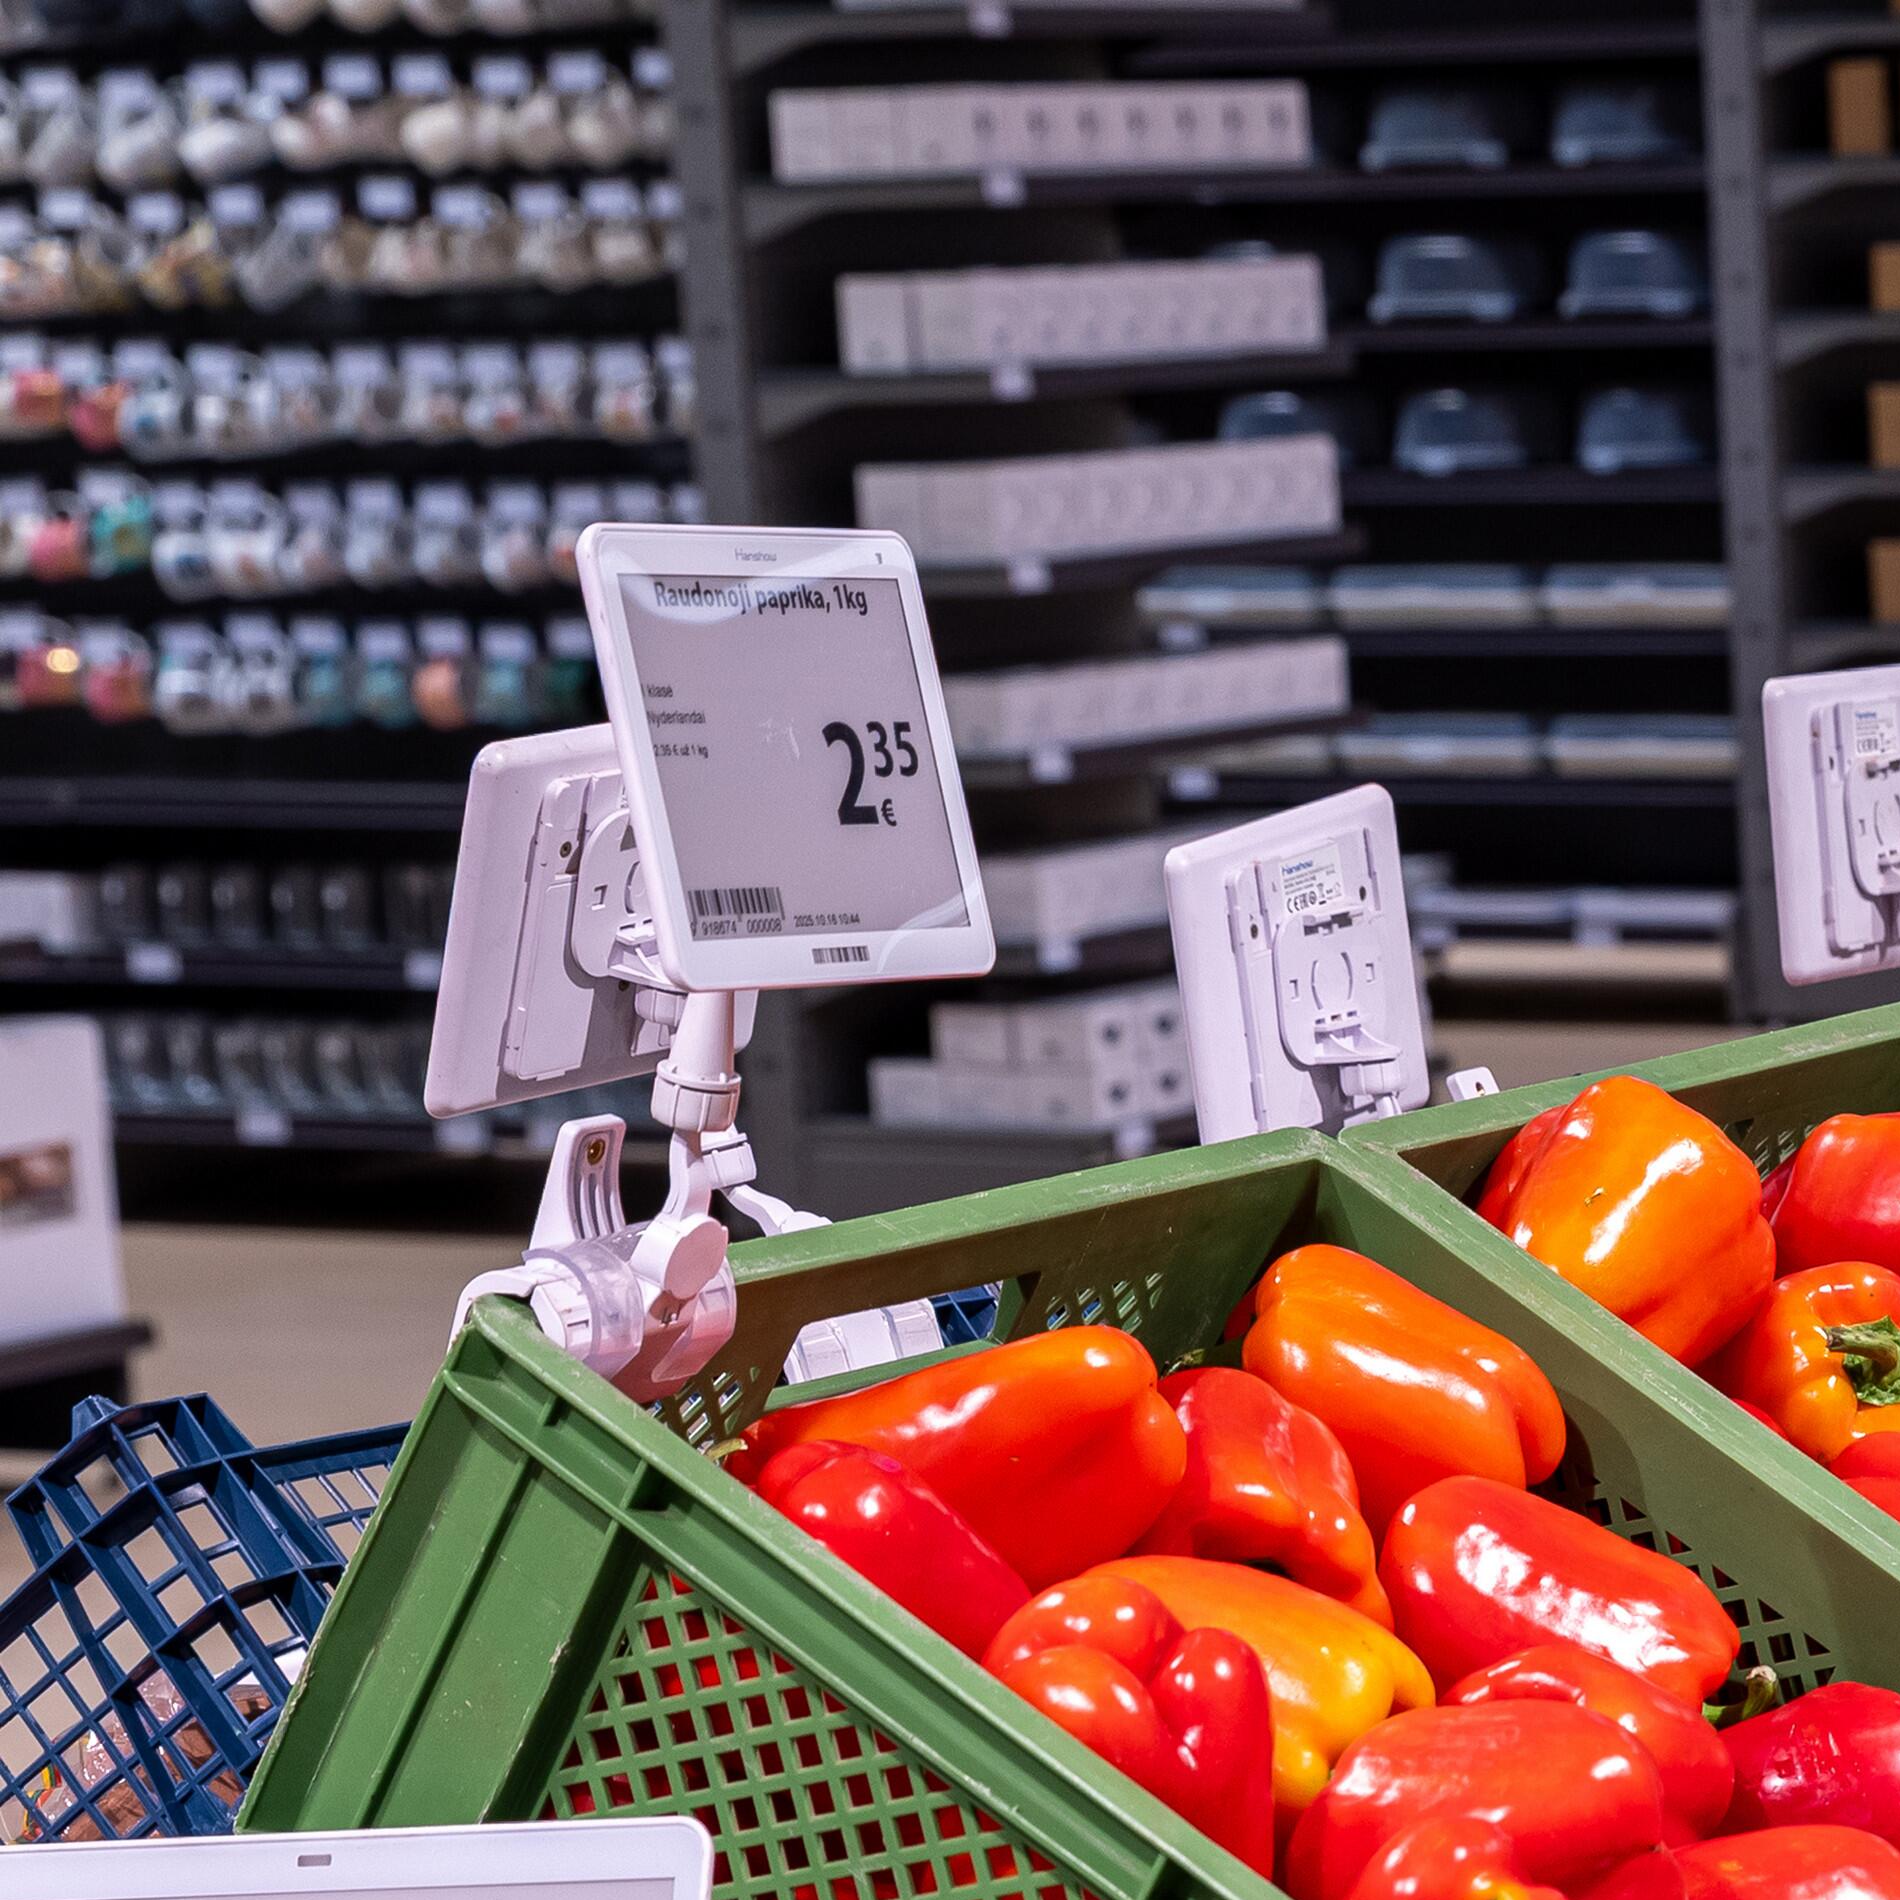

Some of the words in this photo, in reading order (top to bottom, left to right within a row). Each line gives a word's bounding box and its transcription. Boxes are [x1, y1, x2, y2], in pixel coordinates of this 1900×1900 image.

[654, 582, 751, 615] Raudonoji
[756, 584, 831, 615] paprika,
[833, 584, 868, 616] 1kg
[881, 798, 898, 826] €
